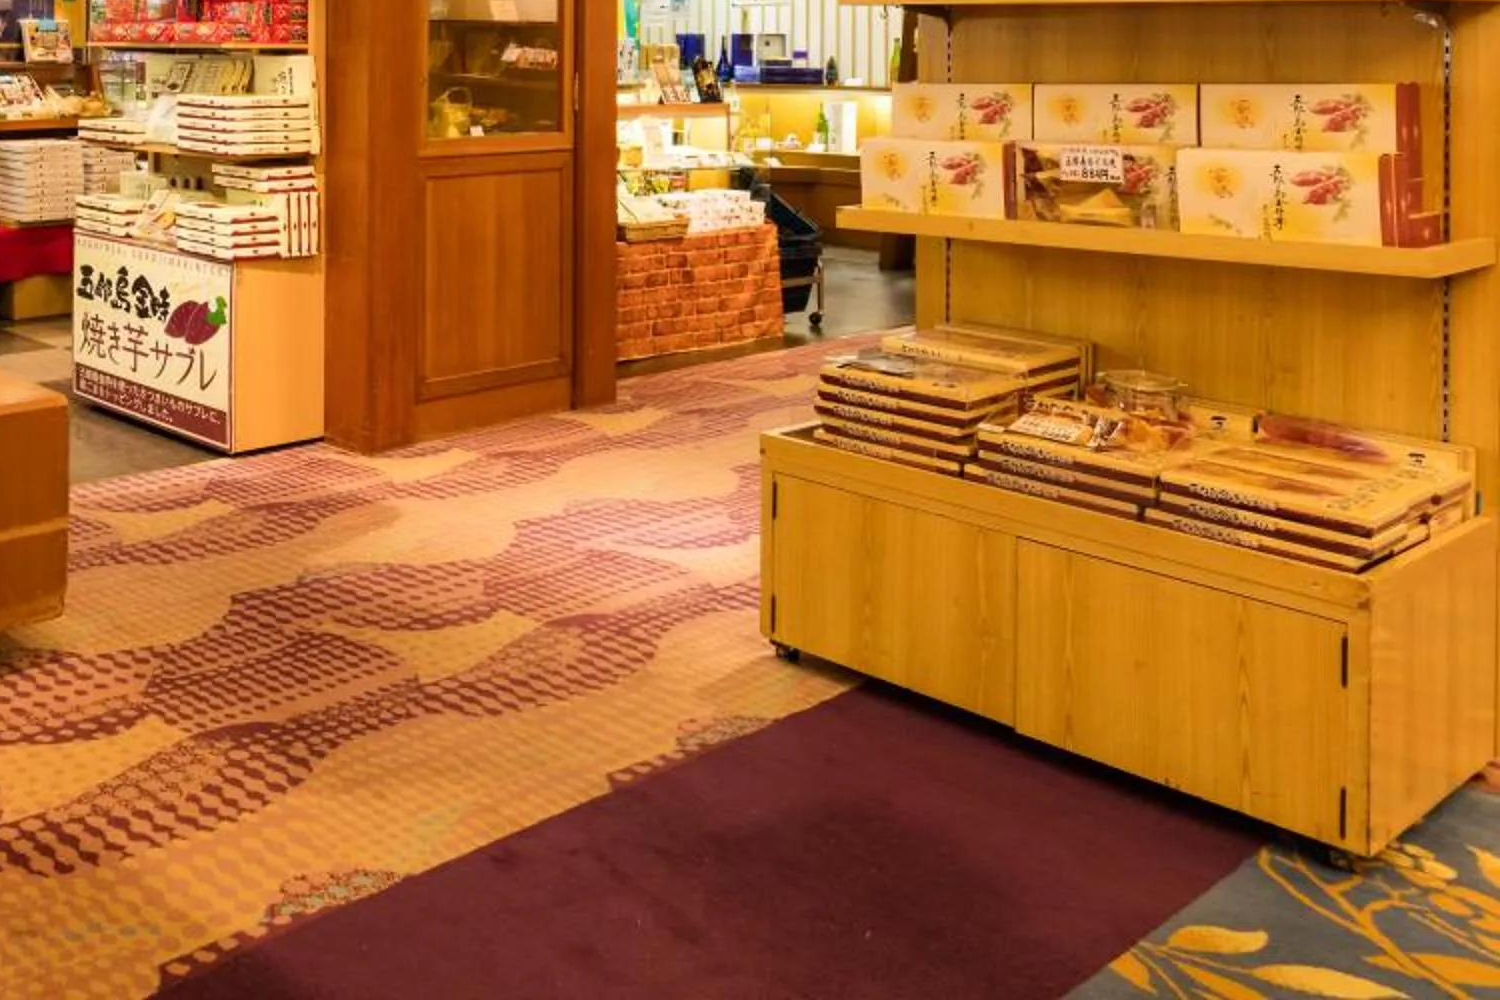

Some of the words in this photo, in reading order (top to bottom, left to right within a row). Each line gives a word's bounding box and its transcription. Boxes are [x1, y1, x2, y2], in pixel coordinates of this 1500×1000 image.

[76, 264, 171, 323] 五郎島金時
[79, 312, 218, 392] 焼き芋サブレ
